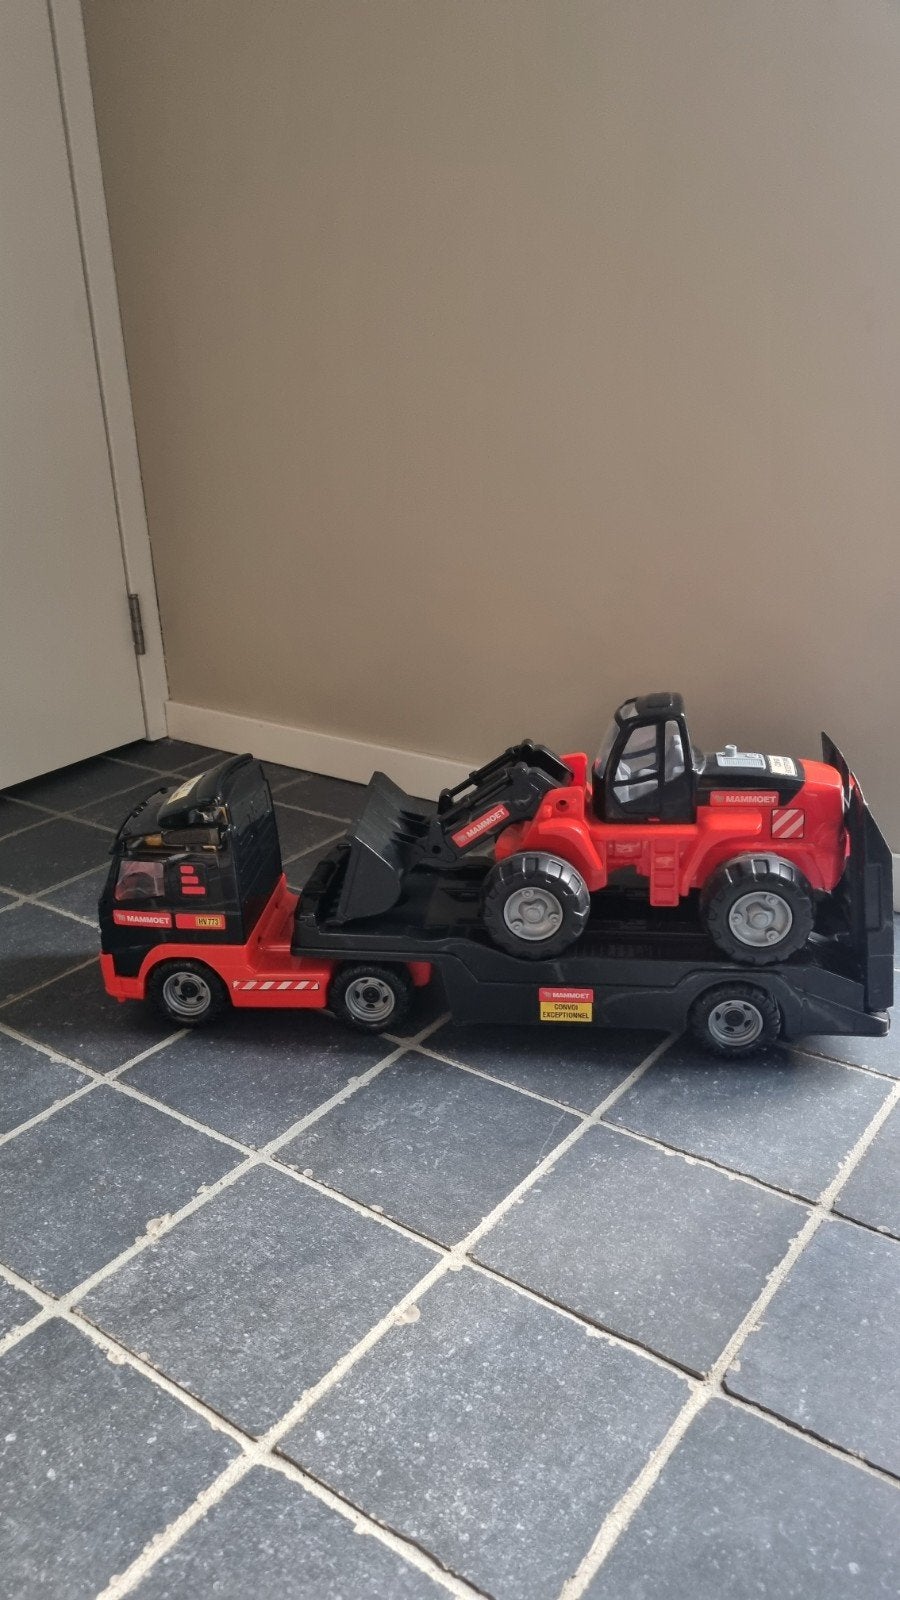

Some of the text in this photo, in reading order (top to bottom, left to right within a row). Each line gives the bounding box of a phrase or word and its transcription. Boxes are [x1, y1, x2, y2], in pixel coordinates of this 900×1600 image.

[725, 795, 777, 803] MAMMOET
[465, 808, 505, 838] MAMMOET
[126, 915, 170, 925] MAMMOET
[554, 1003, 579, 1011] CONVOI
[542, 1011, 590, 1019] EXCEPTIONNEL
